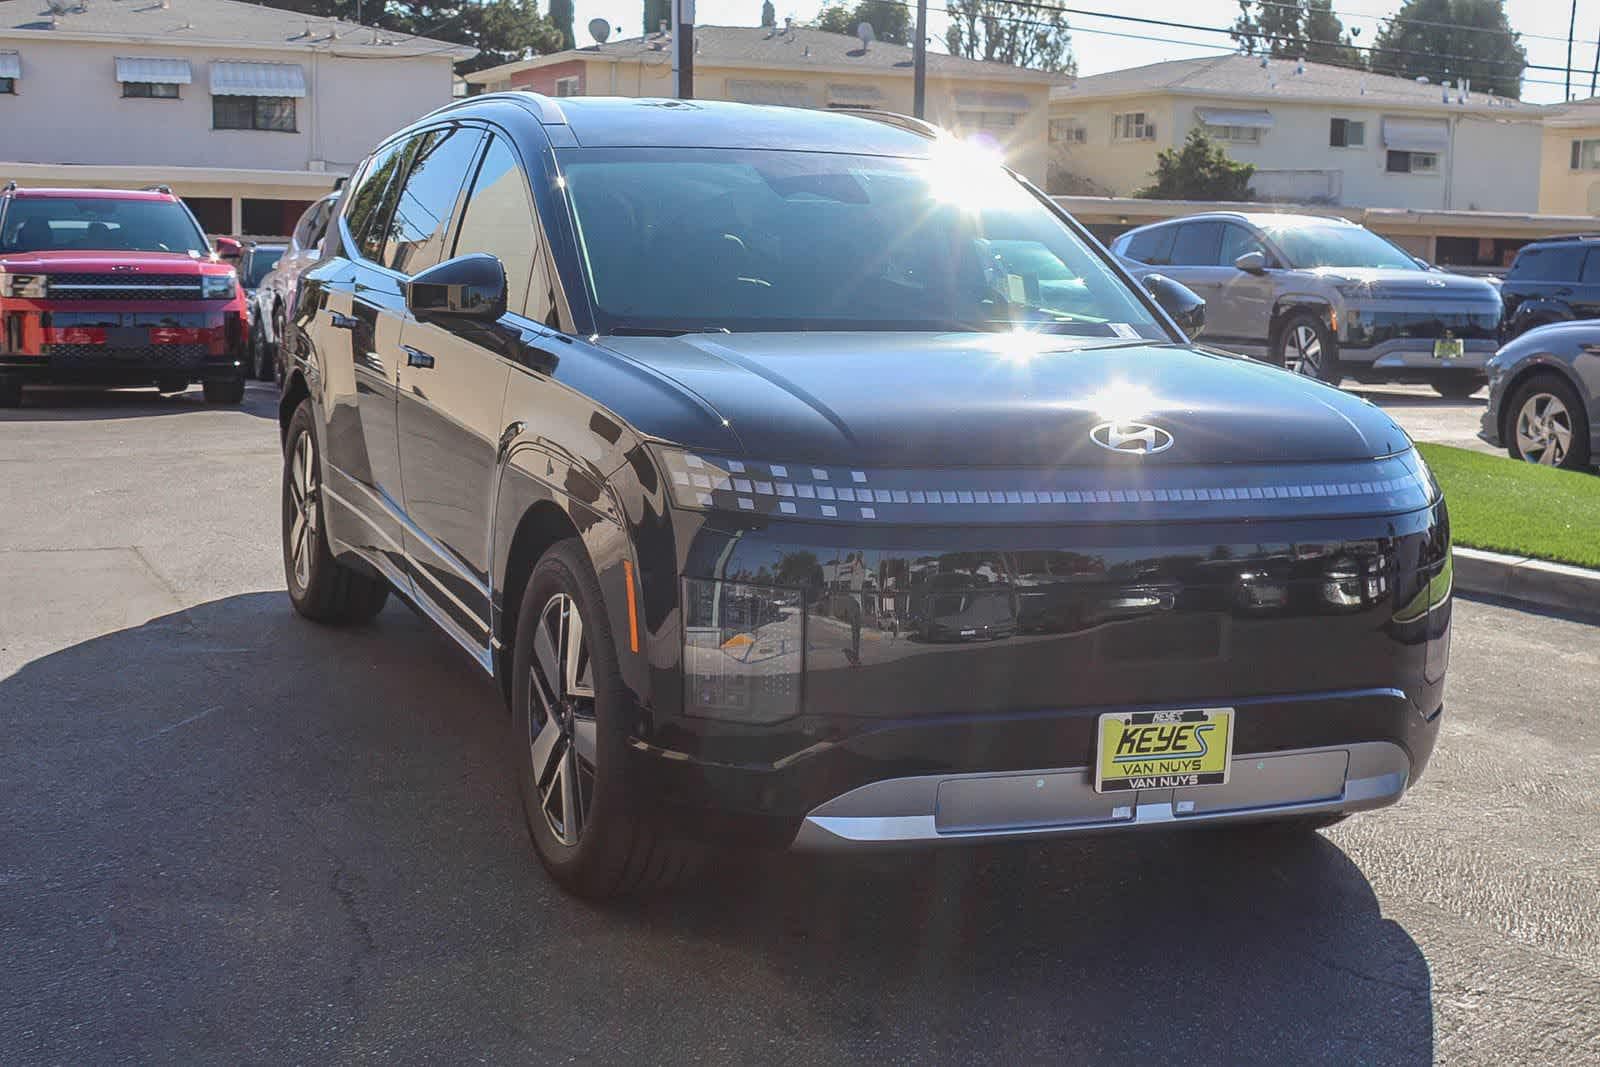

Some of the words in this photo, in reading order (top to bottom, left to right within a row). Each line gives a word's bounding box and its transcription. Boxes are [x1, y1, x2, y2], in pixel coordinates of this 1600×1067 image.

[1114, 724, 1216, 759] KEYES
[1123, 764, 1154, 775] VAN
[1159, 760, 1202, 772] NUYS
[1129, 778, 1156, 789] VAN
[1160, 775, 1199, 786] NUYS
